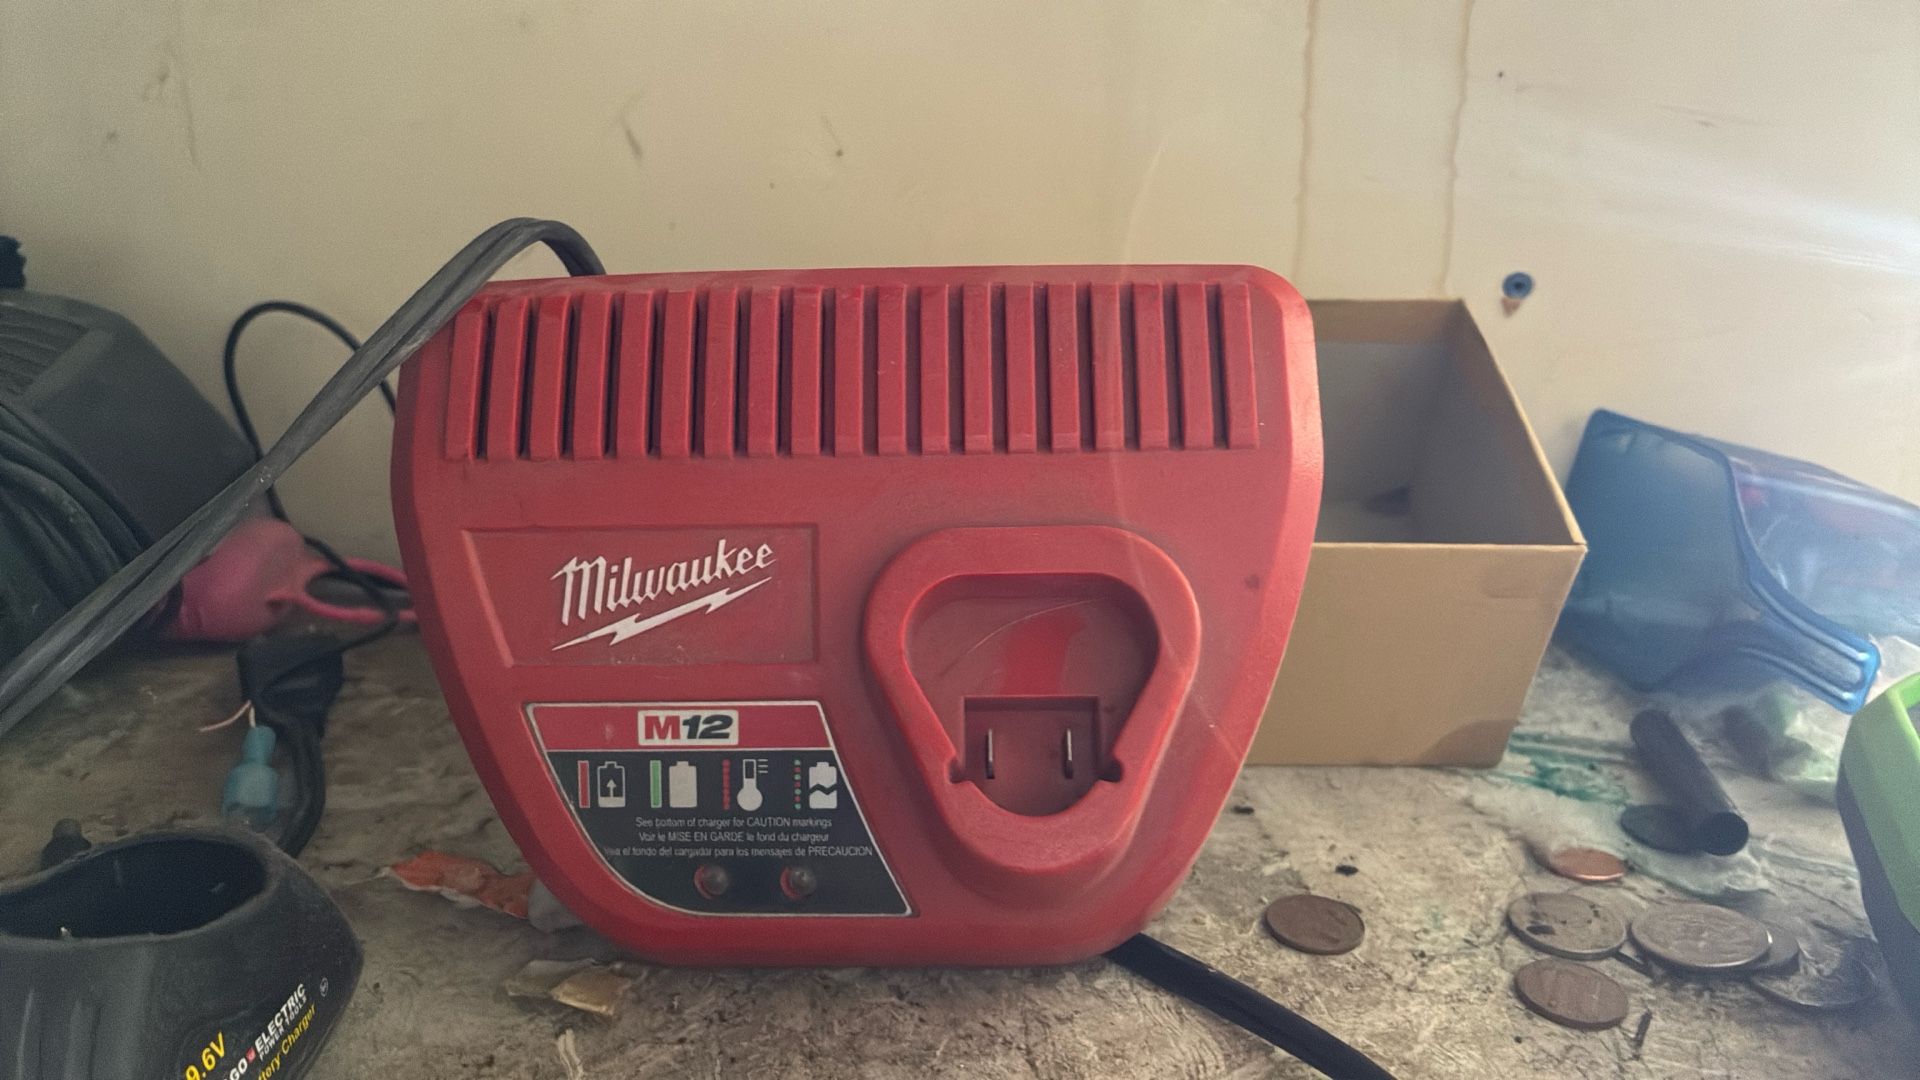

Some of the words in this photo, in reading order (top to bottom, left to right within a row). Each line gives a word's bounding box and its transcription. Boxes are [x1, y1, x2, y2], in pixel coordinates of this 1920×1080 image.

[550, 539, 776, 626] Milwaukee
[644, 714, 734, 740] M12
[635, 816, 654, 828] See
[655, 817, 685, 828] bottom
[687, 817, 697, 828] of
[697, 817, 731, 830] charger
[733, 816, 745, 828] for
[746, 816, 791, 828] CAUTION
[792, 817, 833, 830] markings
[639, 831, 656, 842] Voir
[657, 831, 667, 842] le
[668, 831, 692, 842] MISE
[693, 831, 708, 842] EN
[709, 831, 745, 843] GARDE
[756, 831, 776, 842] fond
[780, 831, 790, 842] du
[790, 831, 830, 845] chargeur
[659, 846, 673, 857] del
[736, 846, 750, 857] los
[750, 846, 793, 859] mensajes
[794, 846, 806, 857] de
[807, 845, 873, 857] PRECAUCION
[224, 1057, 248, 1080] GO
[254, 983, 306, 1054] ELECTRIC
[259, 1023, 285, 1062] POWER
[281, 1001, 315, 1056] Charger
[186, 1031, 225, 1080] 9.6V
